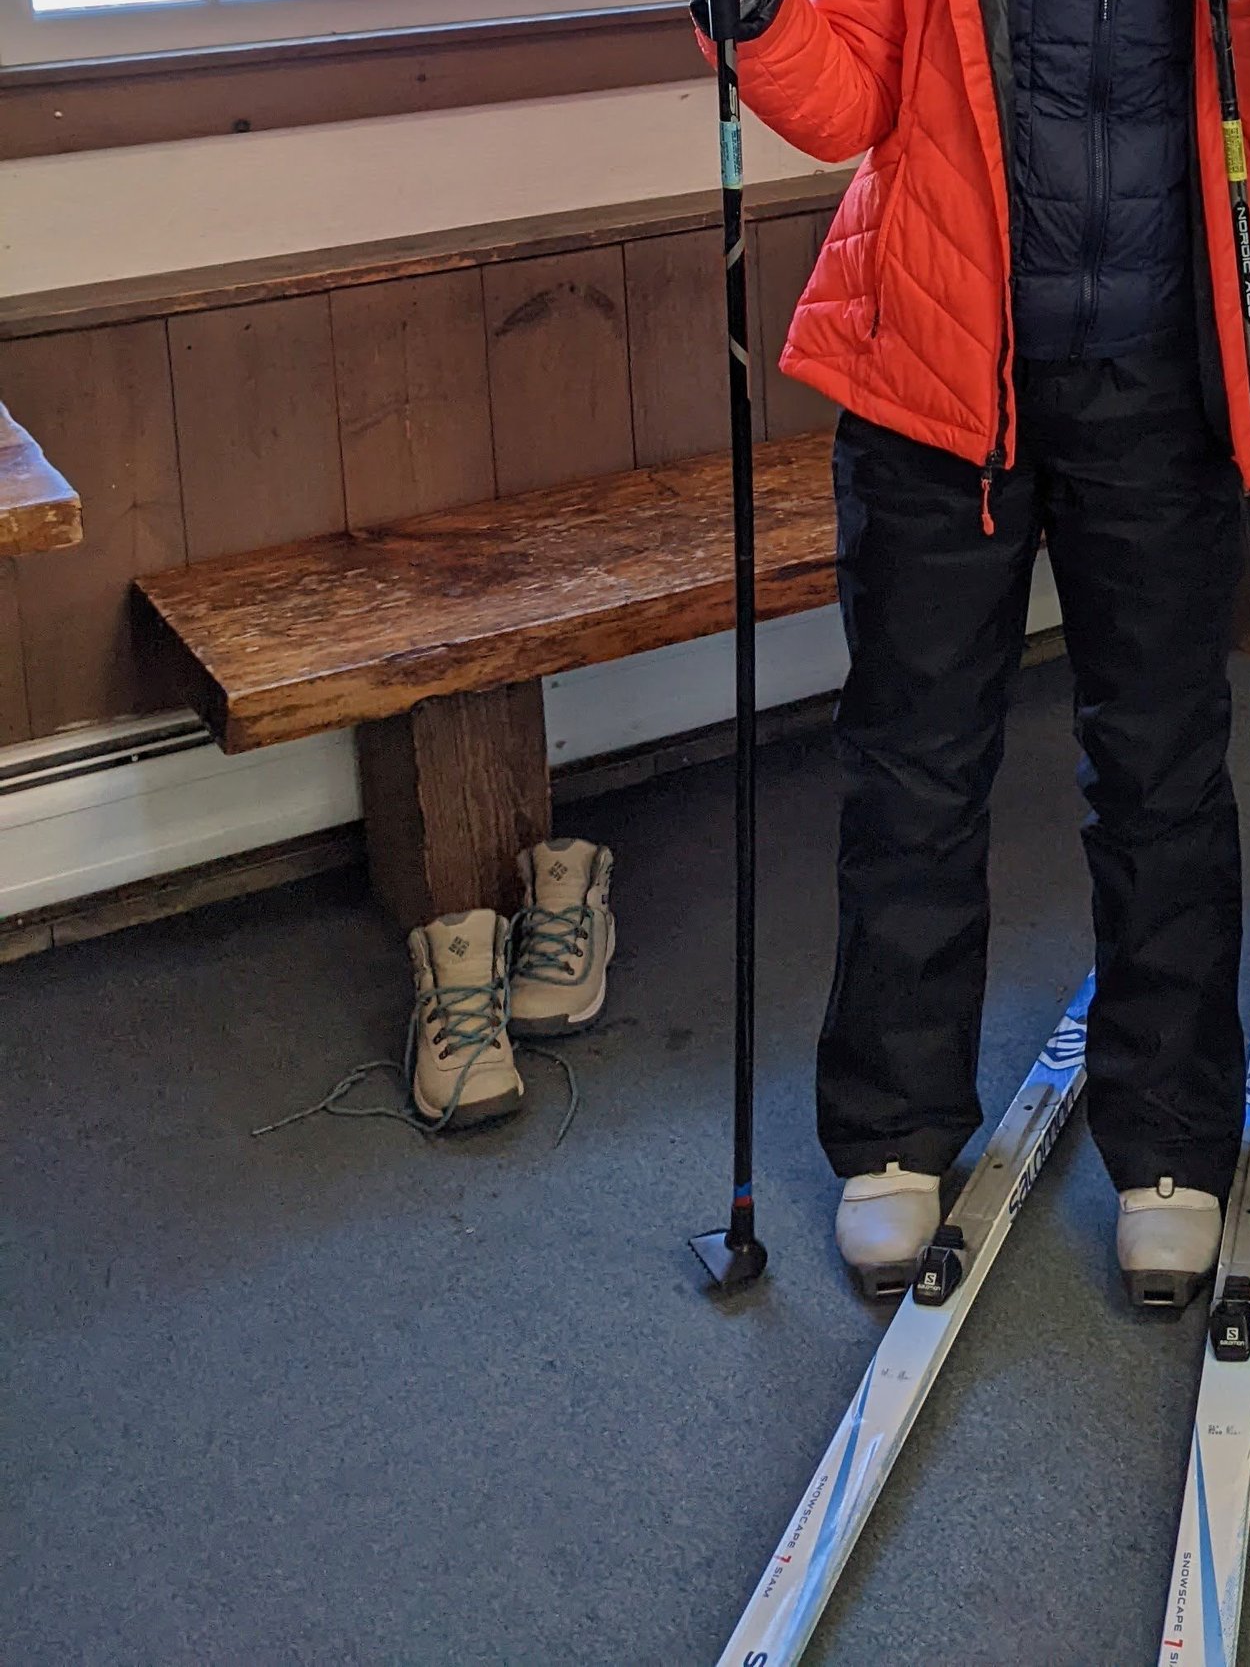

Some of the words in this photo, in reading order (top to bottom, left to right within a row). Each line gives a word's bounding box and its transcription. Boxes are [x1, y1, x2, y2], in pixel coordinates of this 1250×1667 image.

[787, 1474, 829, 1549] SNOWSCAPE
[762, 1566, 783, 1599] SIAM
[1173, 1551, 1192, 1633] SNOWSCAPE
